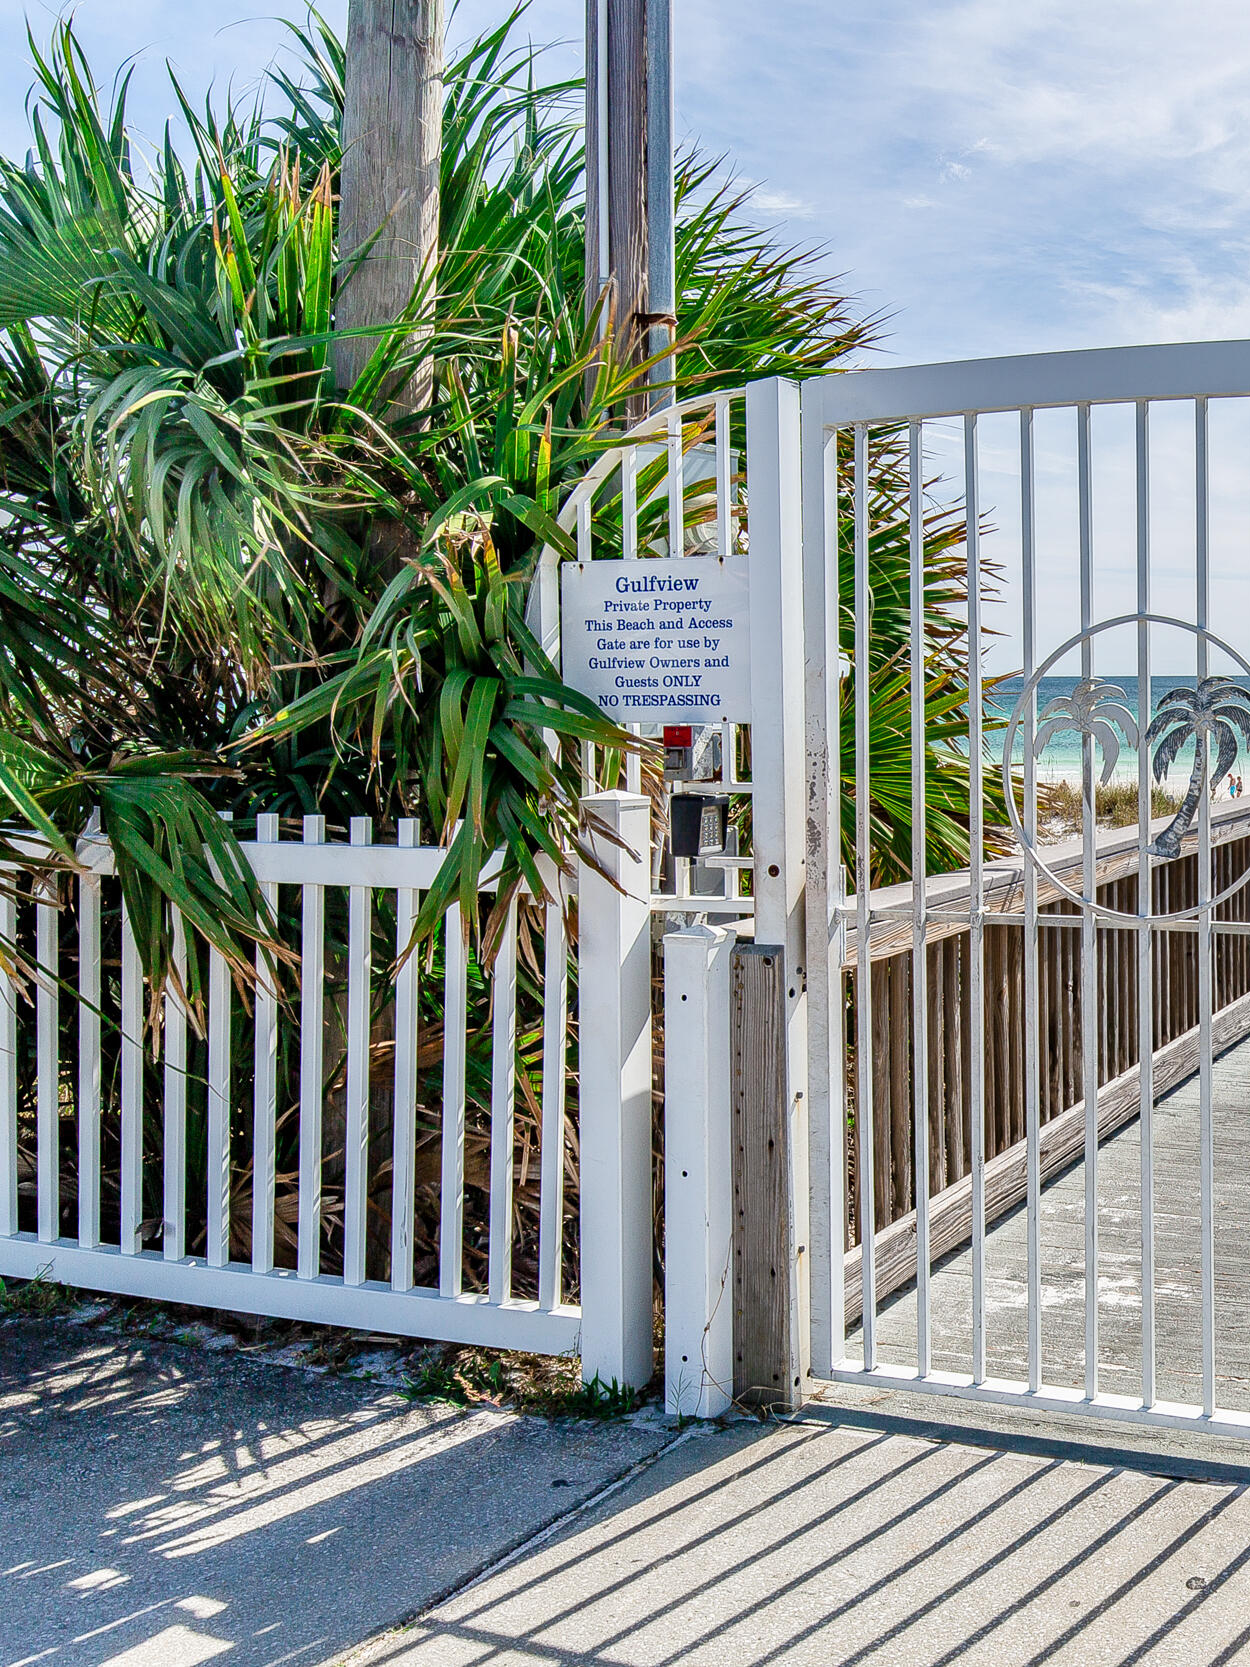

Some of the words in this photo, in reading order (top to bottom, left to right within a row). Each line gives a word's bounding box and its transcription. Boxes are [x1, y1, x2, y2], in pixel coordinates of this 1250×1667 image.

[616, 575, 700, 594] Gulfview
[604, 600, 650, 613] Private
[654, 598, 713, 614] Property
[585, 620, 613, 632] This
[616, 619, 655, 631] Beach
[659, 618, 684, 630] and
[688, 617, 733, 629] Access
[597, 638, 627, 650] Gate
[629, 640, 651, 650] are
[654, 637, 674, 650] for
[677, 639, 701, 649] use
[704, 636, 721, 651] by
[588, 657, 646, 670] Gulfview
[649, 656, 701, 669] Owners
[704, 656, 730, 668] and
[615, 676, 659, 688] Guests
[662, 675, 703, 687] ONLY
[598, 695, 620, 707] NO
[622, 693, 722, 707] TRESPASSING
